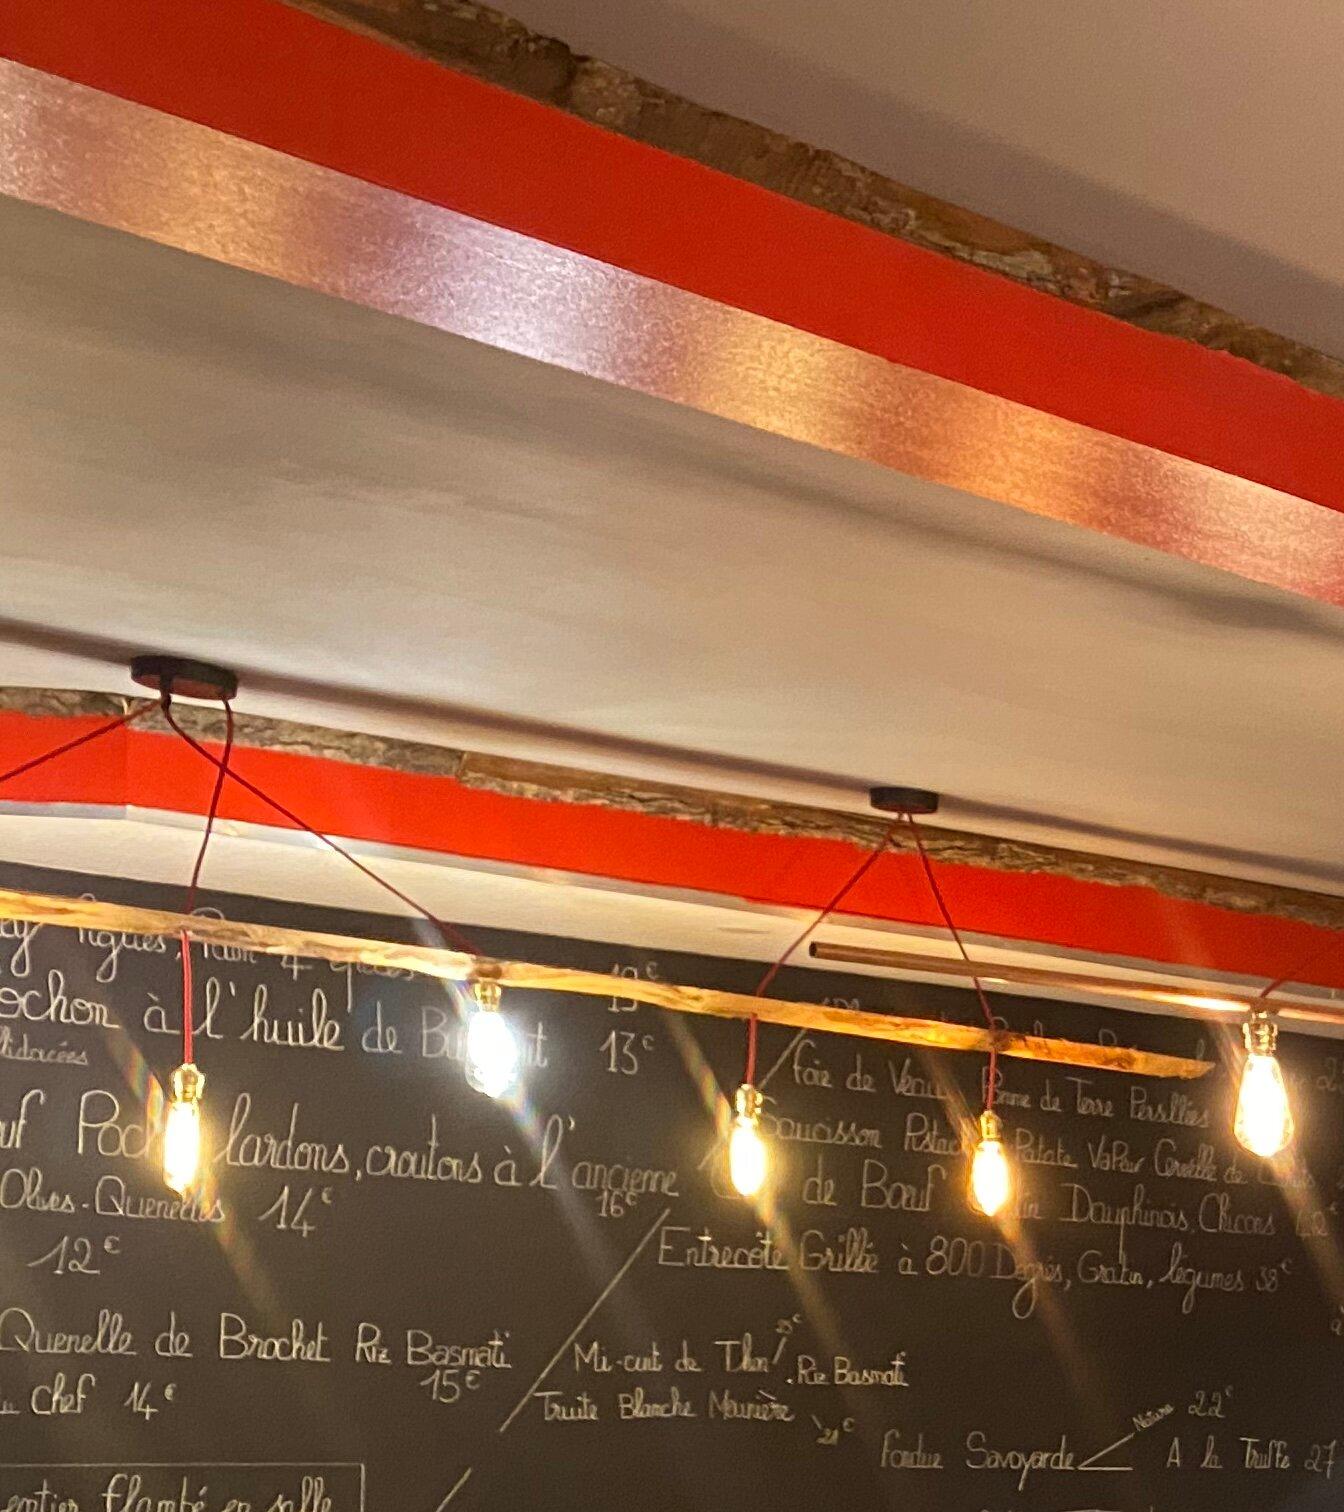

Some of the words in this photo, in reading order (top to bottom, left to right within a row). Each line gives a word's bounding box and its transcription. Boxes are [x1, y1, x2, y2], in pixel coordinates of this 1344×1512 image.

[143, 992, 181, 1034] à
[361, 1000, 402, 1054] de
[845, 1053, 878, 1093] de
[1040, 1079, 1063, 1113] de
[494, 1145, 522, 1187] à
[803, 1154, 838, 1206] de
[27, 1235, 121, 1275] 12€
[899, 1242, 918, 1276] à
[0, 1307, 137, 1355] Quenelle
[154, 1311, 193, 1358] de
[219, 1312, 331, 1362] Brochet
[354, 1322, 392, 1364] Riz
[406, 1329, 512, 1369] Basmati
[674, 1339, 703, 1373] de
[31, 1372, 96, 1416] Chef
[420, 1368, 481, 1404] 15€
[617, 1386, 697, 1421] Blanche
[965, 1430, 1076, 1492] Savoyarde
[1165, 1436, 1182, 1469] A
[1200, 1434, 1224, 1469] la
